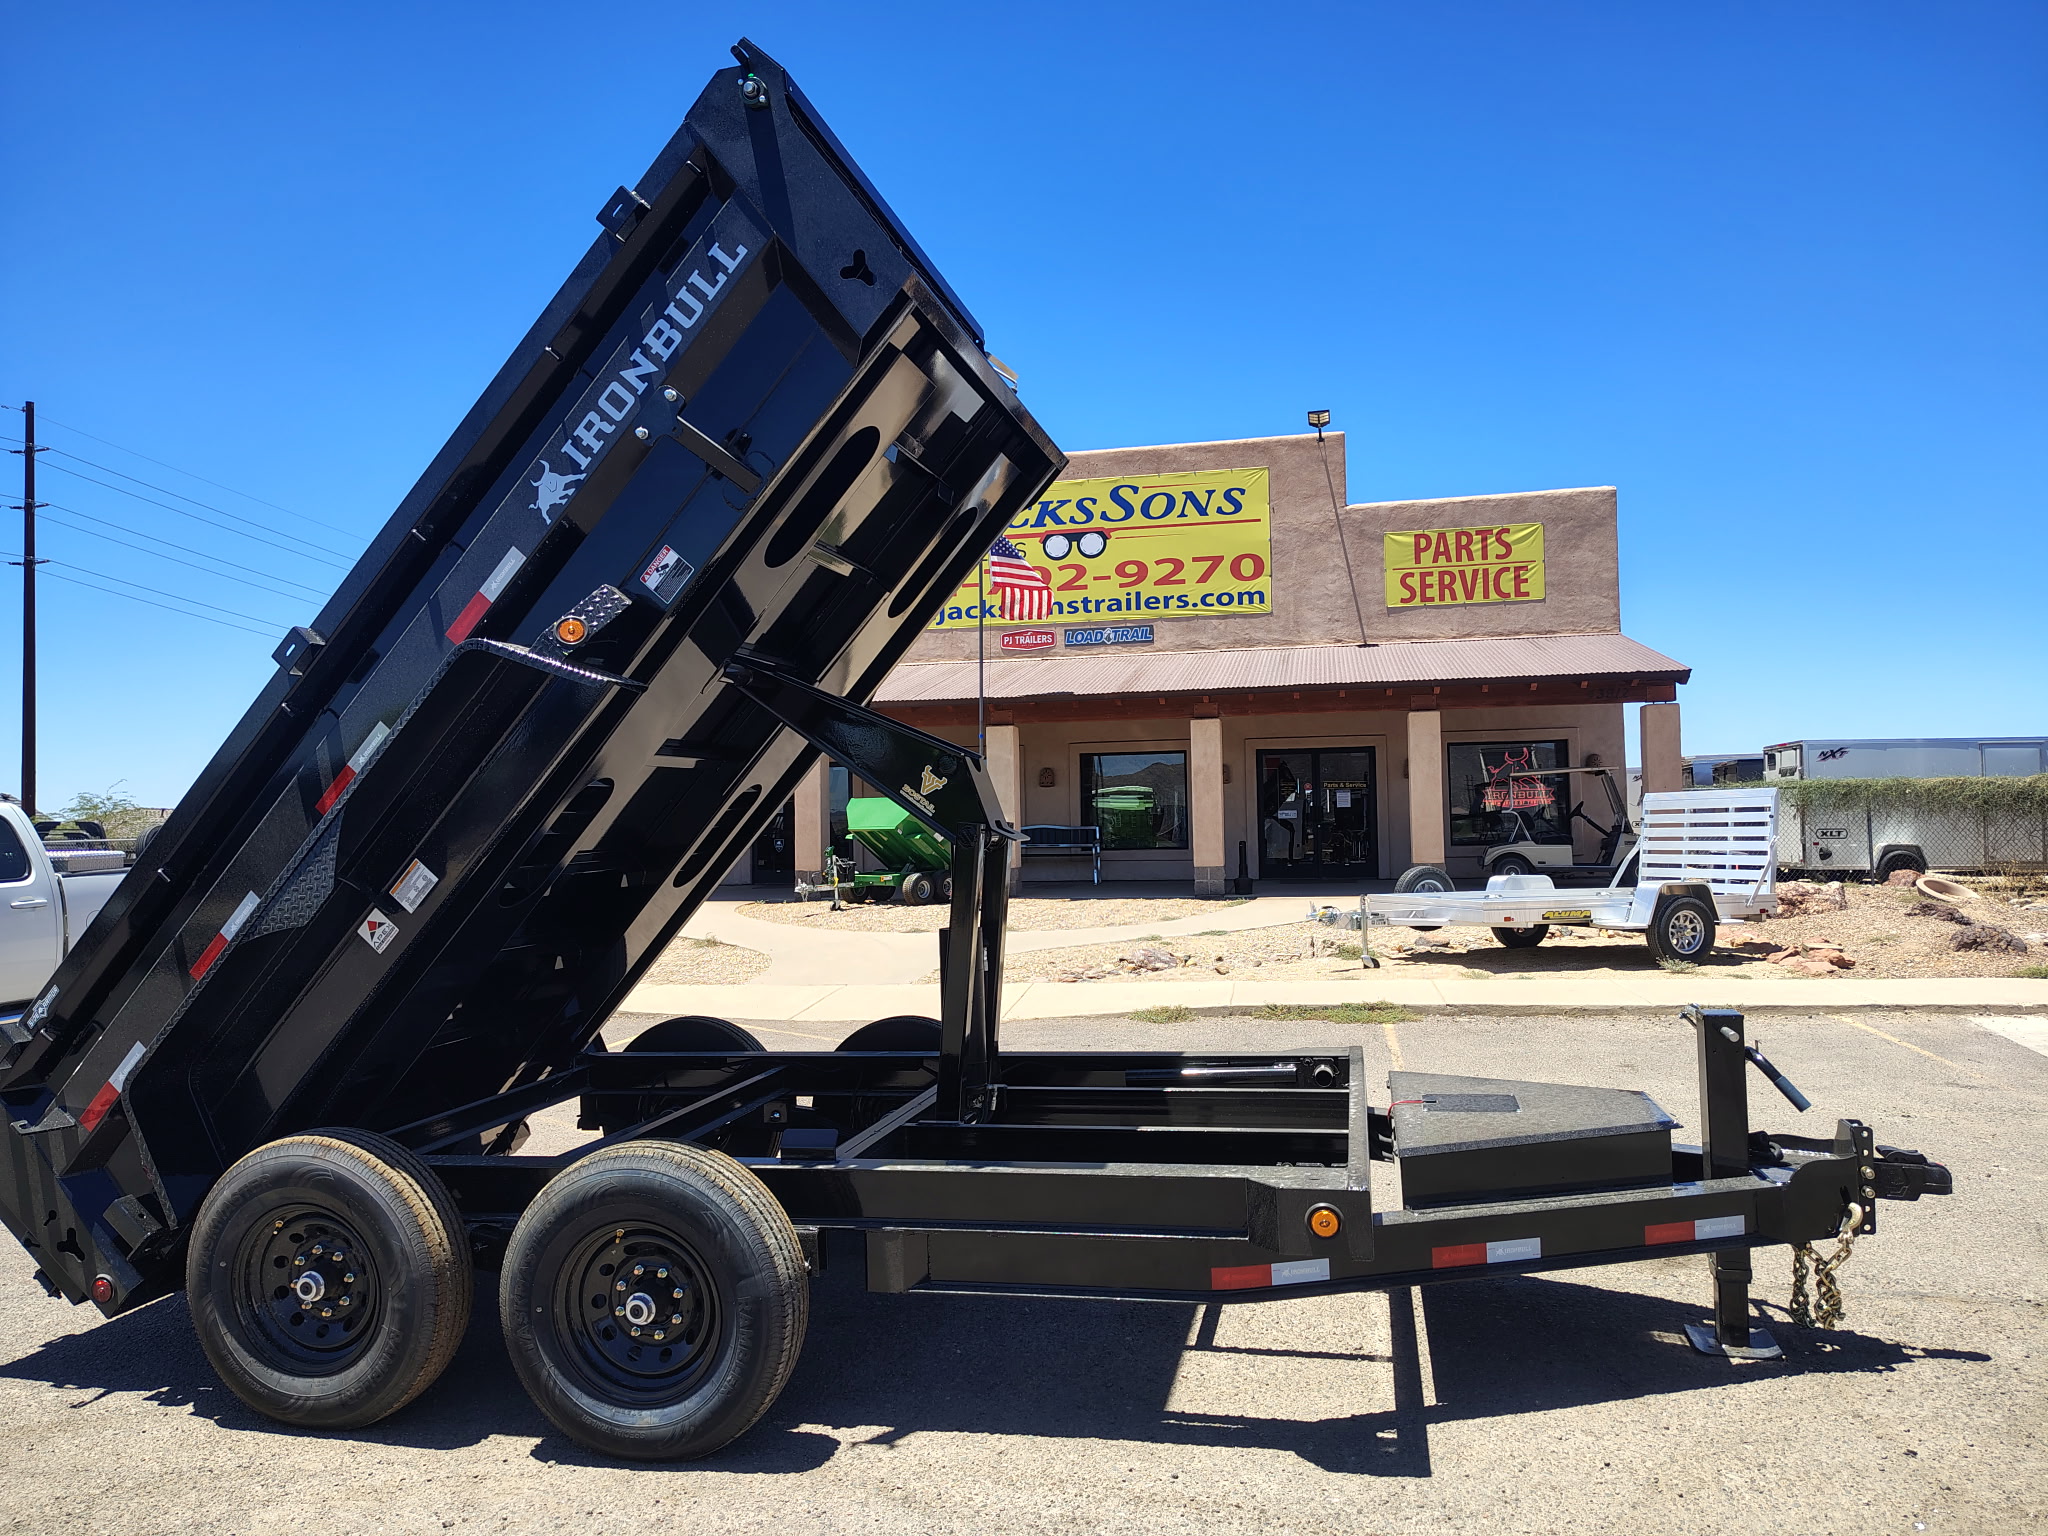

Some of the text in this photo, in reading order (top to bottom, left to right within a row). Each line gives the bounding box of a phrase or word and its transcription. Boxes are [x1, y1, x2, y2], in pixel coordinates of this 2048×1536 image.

[561, 242, 748, 470] IRONBULL
[1413, 527, 1513, 565] PARTS
[648, 549, 669, 575] DANGER
[1400, 565, 1530, 604] SERVICE
[1003, 634, 1053, 645] PJ TRAILERS
[1065, 627, 1153, 644] LOAD TRAIL
[1816, 747, 1851, 762] NXT
[1487, 790, 1549, 800] IRONBULL
[373, 922, 393, 948] APEX
